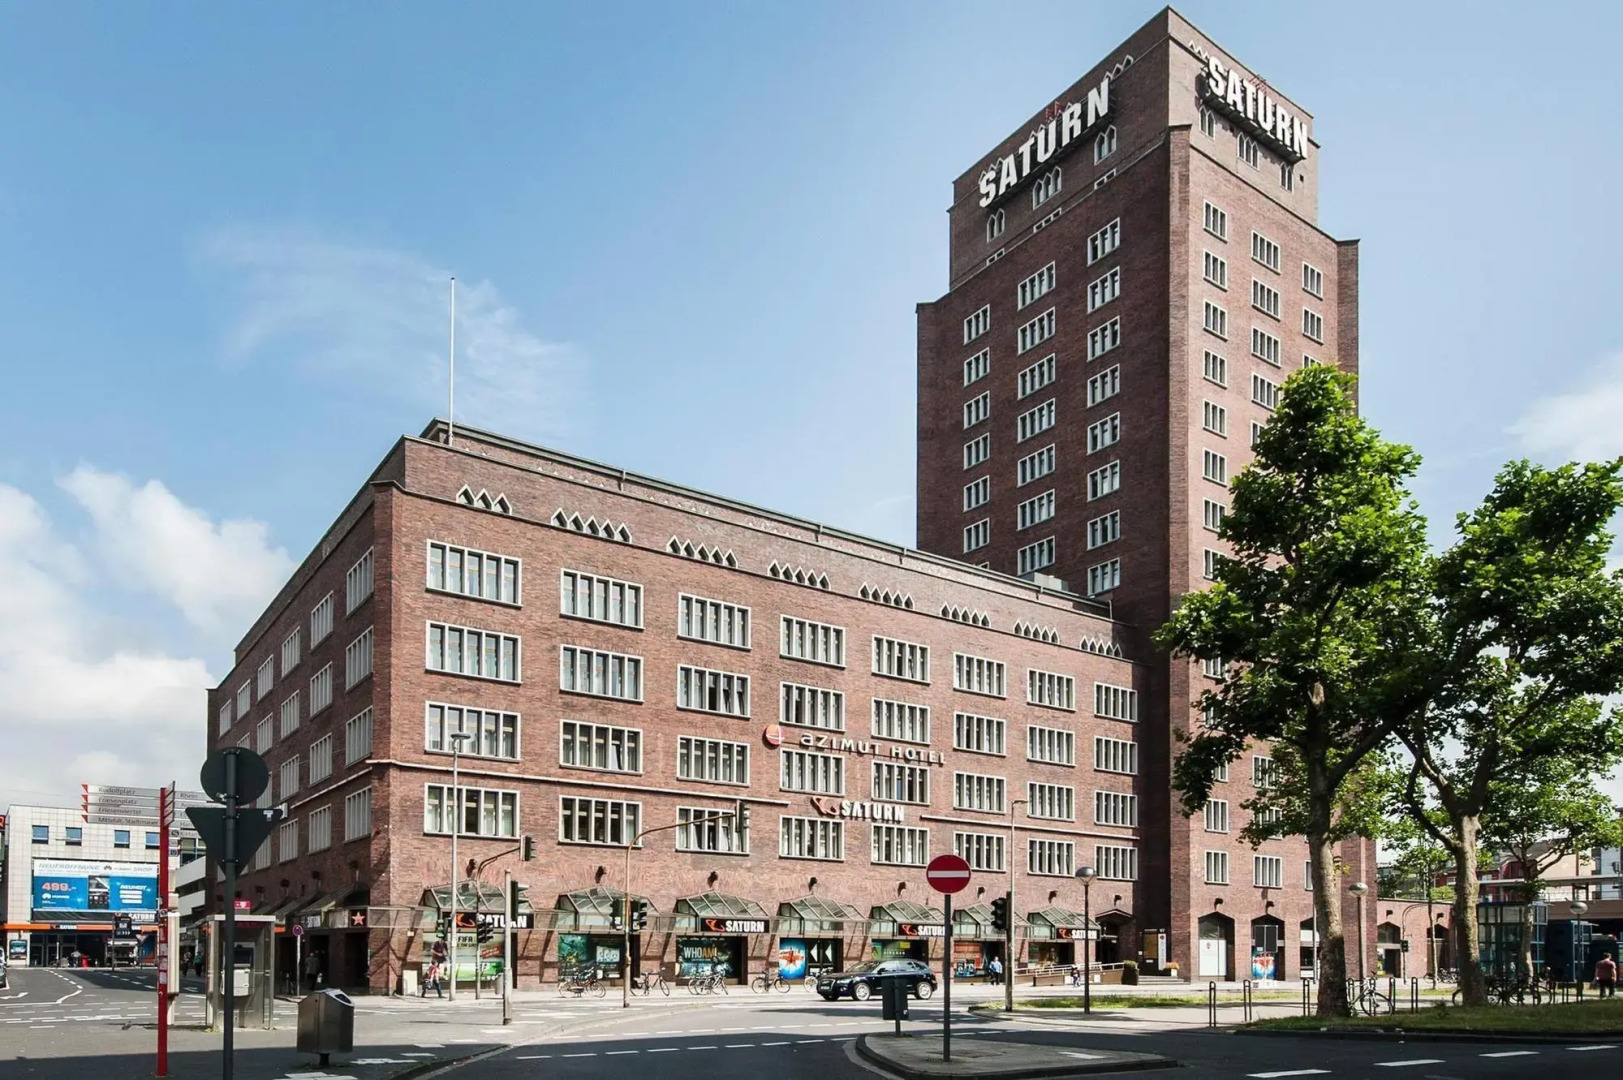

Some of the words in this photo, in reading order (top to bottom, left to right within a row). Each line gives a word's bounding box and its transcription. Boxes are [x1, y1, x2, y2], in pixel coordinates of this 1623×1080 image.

[1209, 55, 1308, 160] SATURN
[979, 77, 1109, 208] SATURN
[891, 745, 948, 764] HOTEL
[98, 787, 136, 795] Rudolfplatz
[840, 799, 905, 822] SATURN
[725, 920, 765, 932] SATURN
